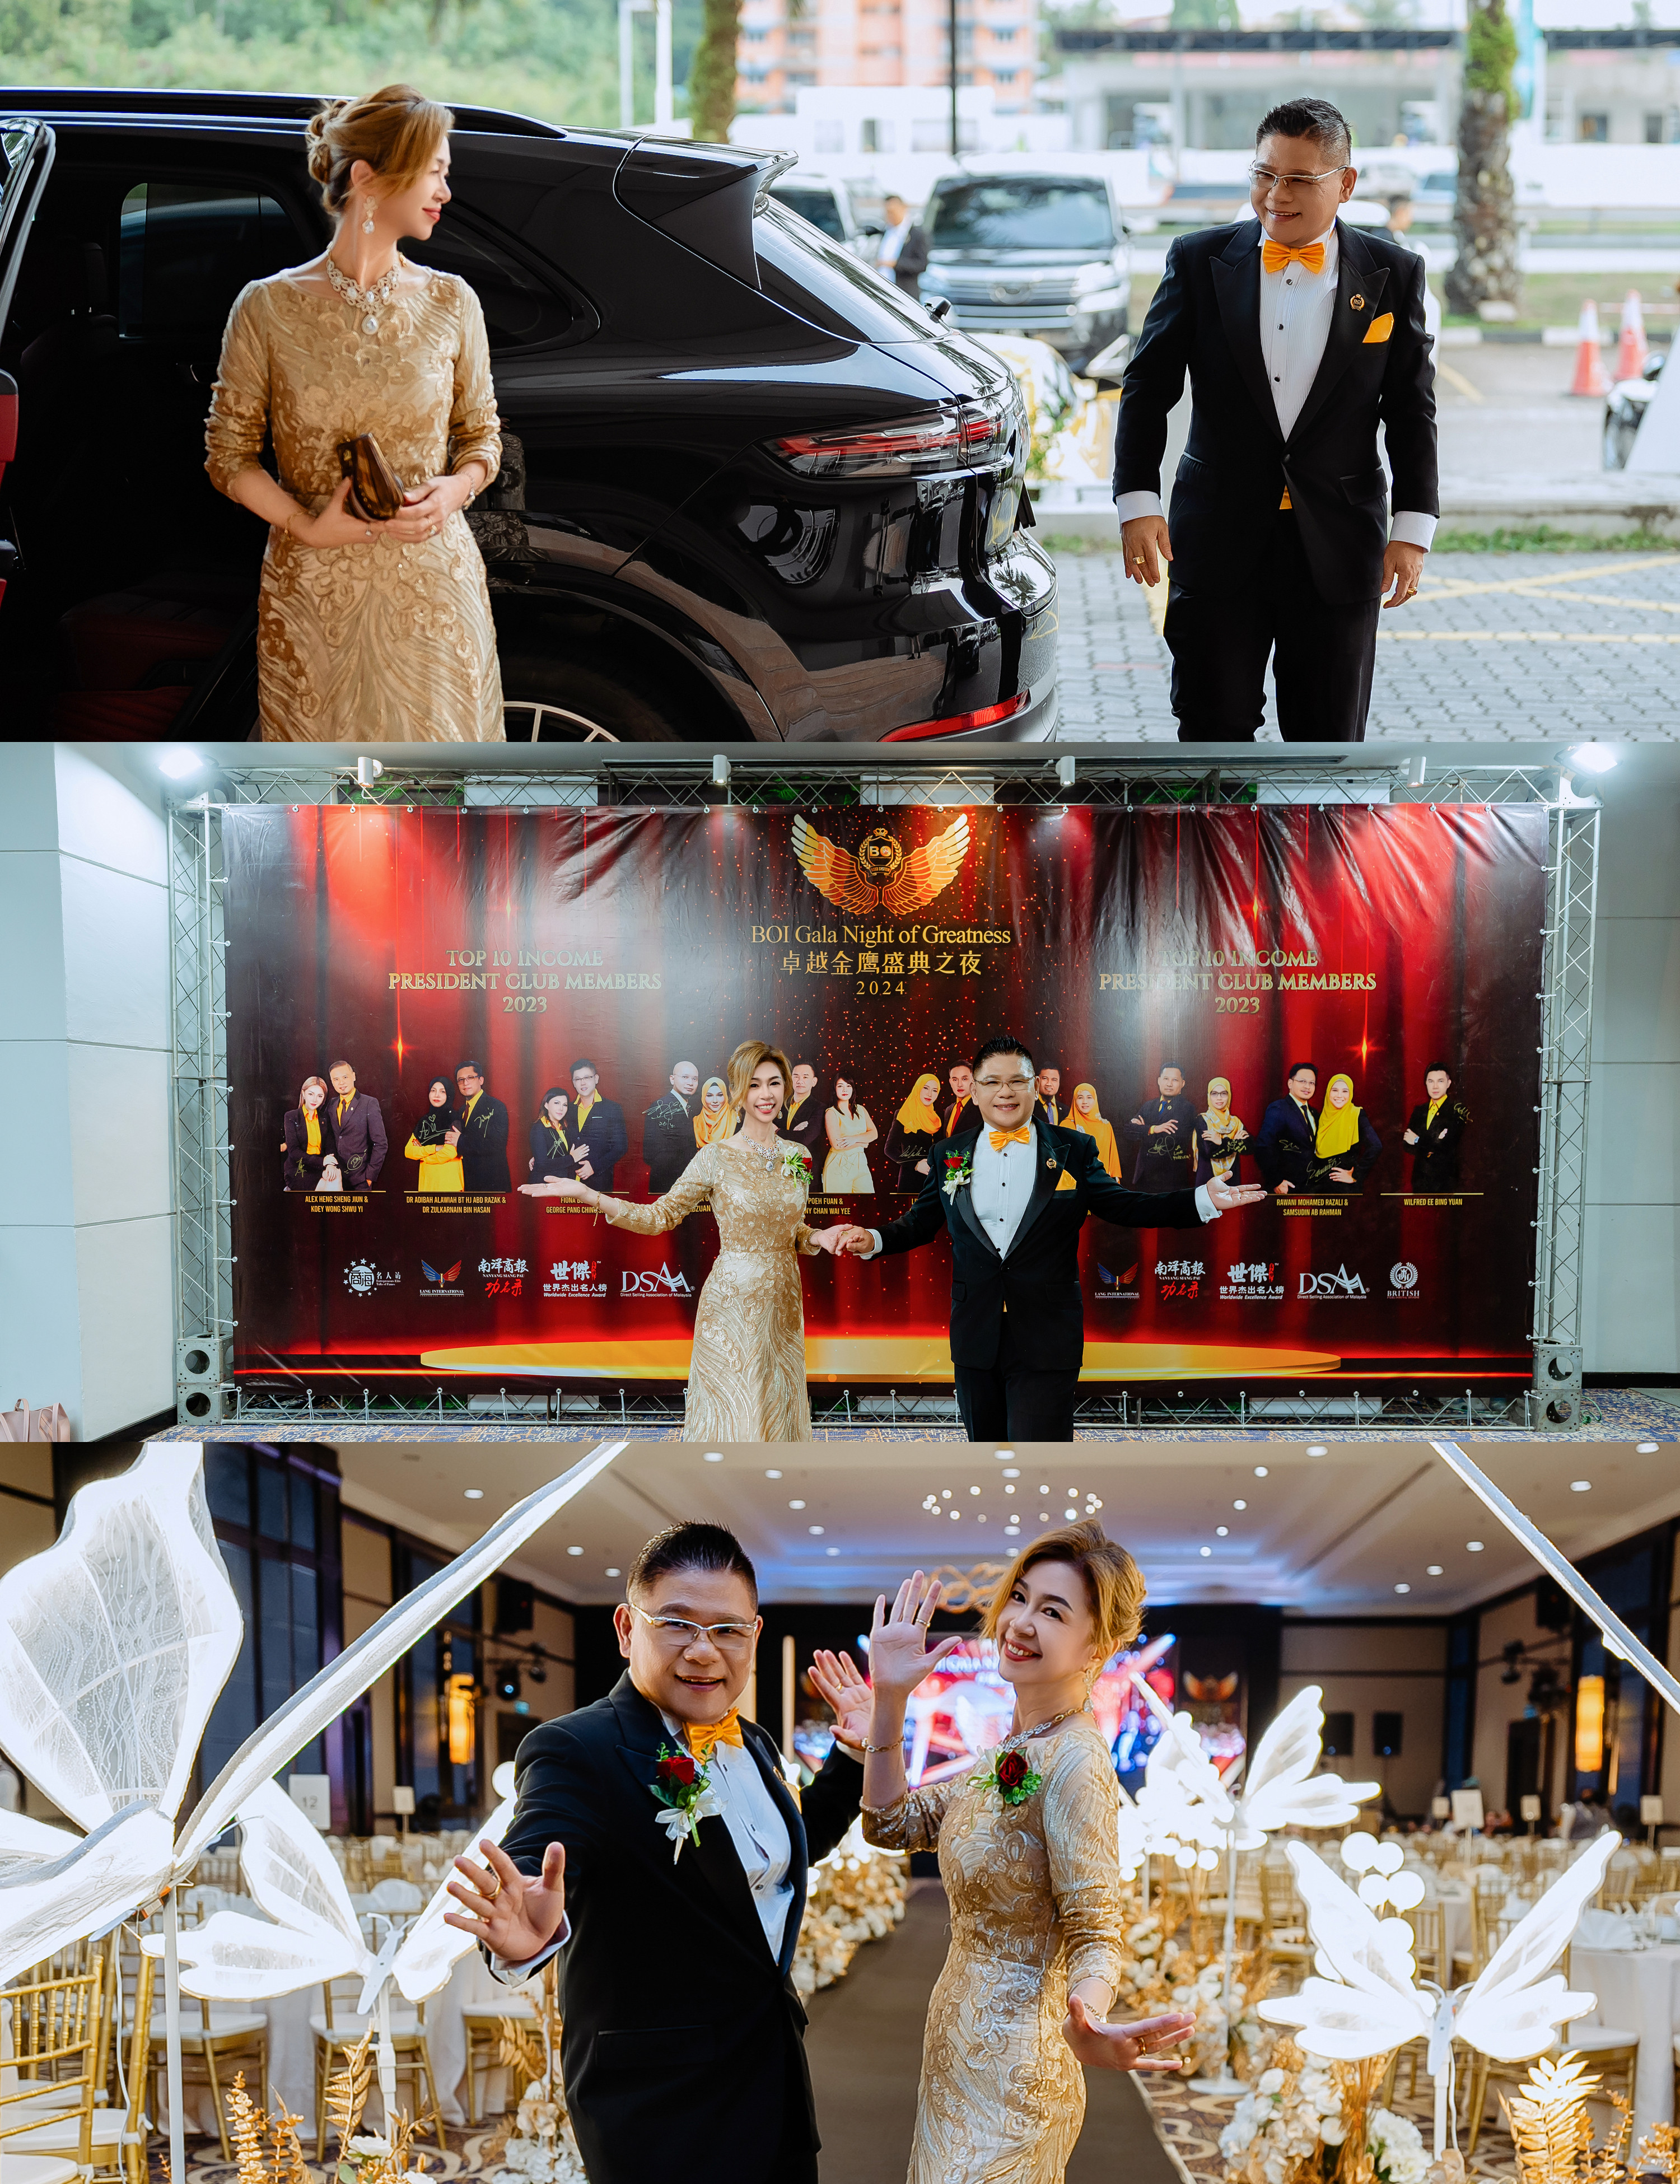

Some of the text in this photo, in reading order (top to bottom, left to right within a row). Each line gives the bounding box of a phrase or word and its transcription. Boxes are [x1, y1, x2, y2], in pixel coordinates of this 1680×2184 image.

[750, 925, 1011, 948] BOI Gala Night of Greatness
[446, 950, 603, 967] TOP 10 INCOME
[780, 950, 982, 976] 卓越金鹰盛典之夜
[1161, 950, 1318, 967] TOP 10 INCOME
[389, 973, 662, 990] PRESIDENT CLUB MEMBERS
[856, 981, 905, 995] 2024
[1099, 973, 1376, 990] PRESIDENT CLUB MEMBERS
[502, 996, 547, 1013] 2023
[1215, 996, 1261, 1014] 2023
[478, 1258, 529, 1273] 南洋商報
[1155, 1260, 1206, 1276] 南洋商報
[543, 1284, 607, 1292] 世界杰出名人榜
[1220, 1286, 1284, 1294] 世界杰出名人榜
